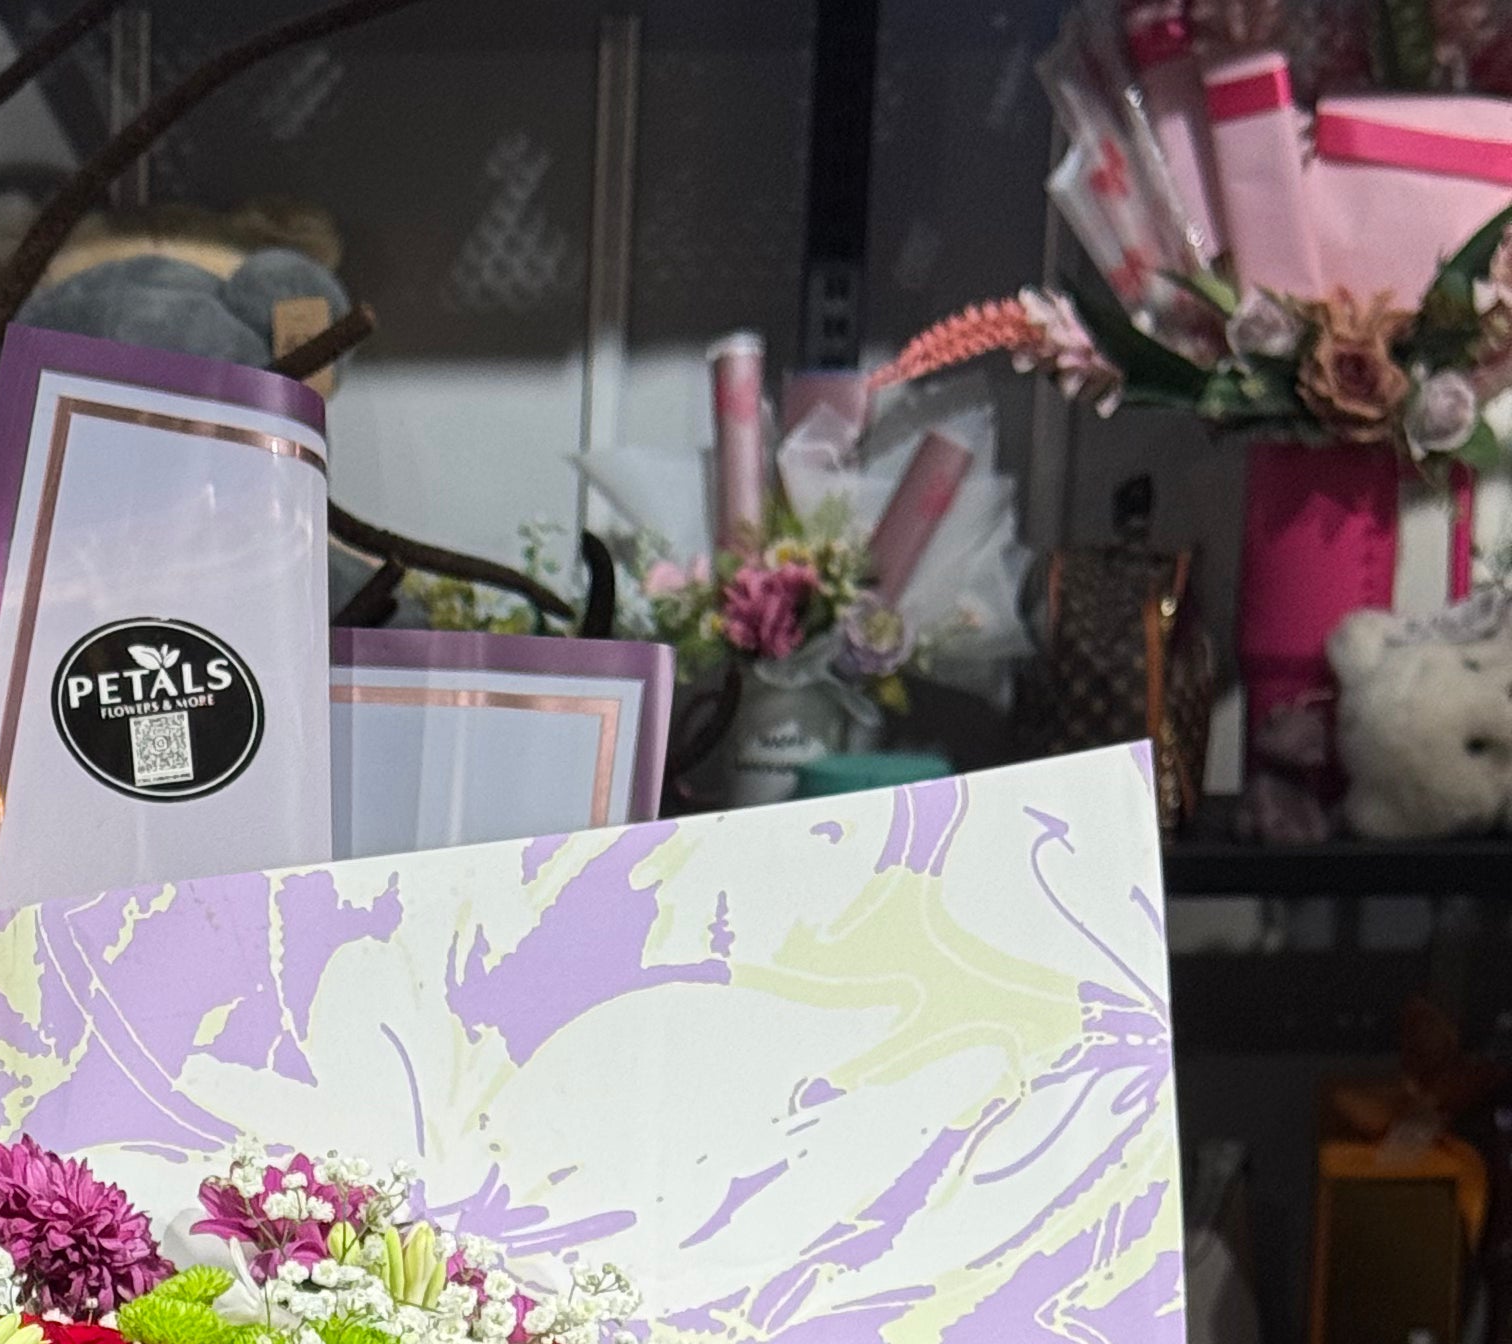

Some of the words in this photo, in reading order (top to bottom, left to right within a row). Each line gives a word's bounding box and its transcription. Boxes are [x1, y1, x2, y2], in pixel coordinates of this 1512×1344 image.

[67, 658, 232, 708] PETALS
[101, 702, 159, 719] FLOWERS
[162, 701, 173, 711] &
[175, 694, 216, 710] MORE
